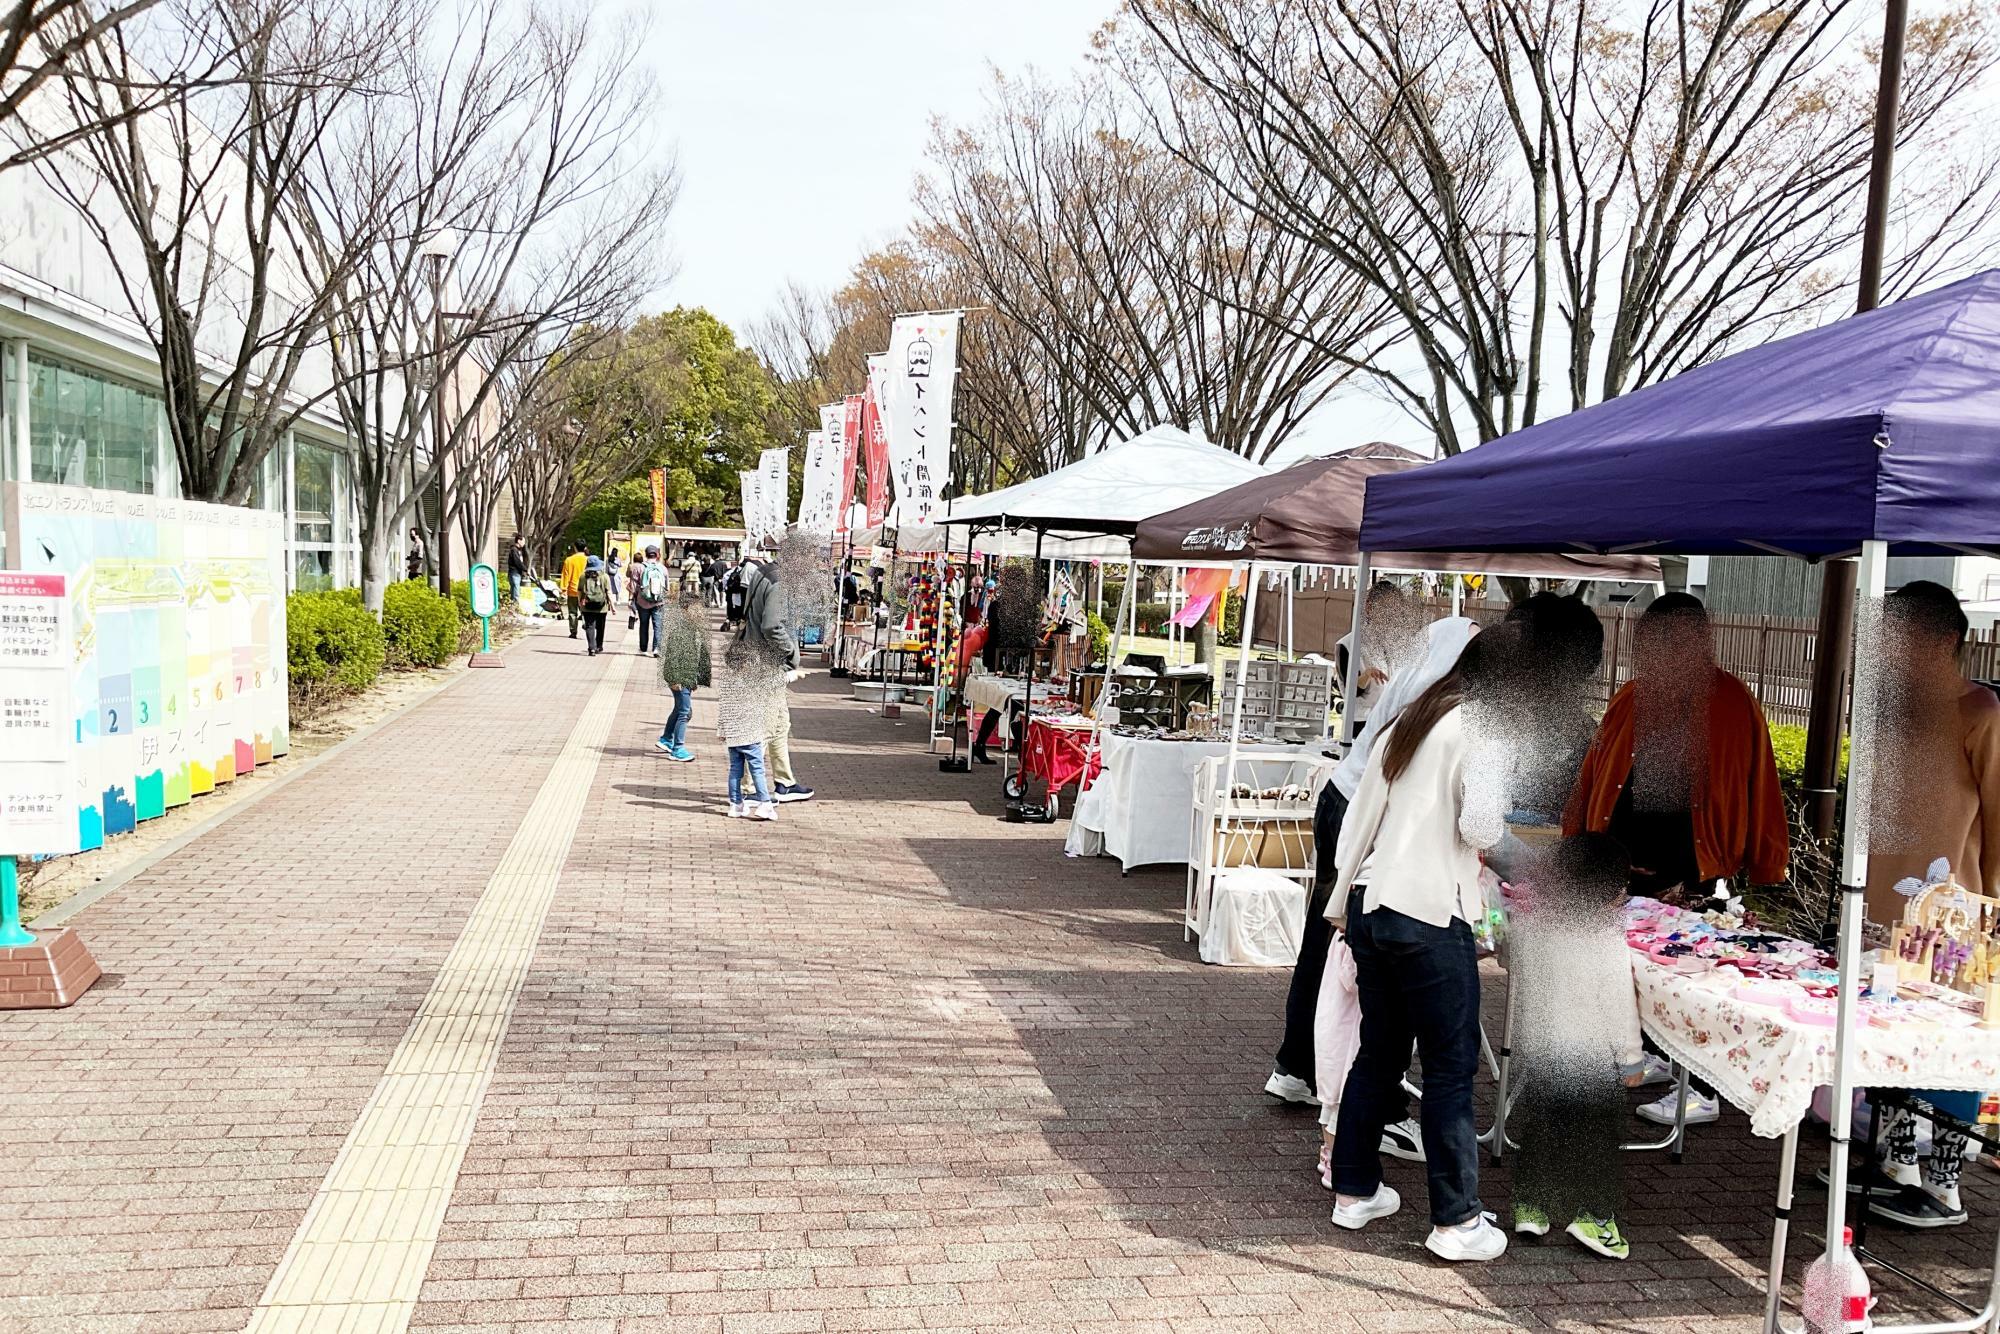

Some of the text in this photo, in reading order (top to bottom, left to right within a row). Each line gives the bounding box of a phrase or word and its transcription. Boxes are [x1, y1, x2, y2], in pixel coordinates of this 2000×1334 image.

[235, 676, 243, 694] 7
[255, 671, 262, 689] 8
[272, 666, 279, 684] 9
[192, 688, 201, 708] 5
[215, 681, 223, 701] 6
[139, 701, 149, 724] 3
[168, 694, 177, 716] 4
[108, 708, 119, 733] 2
